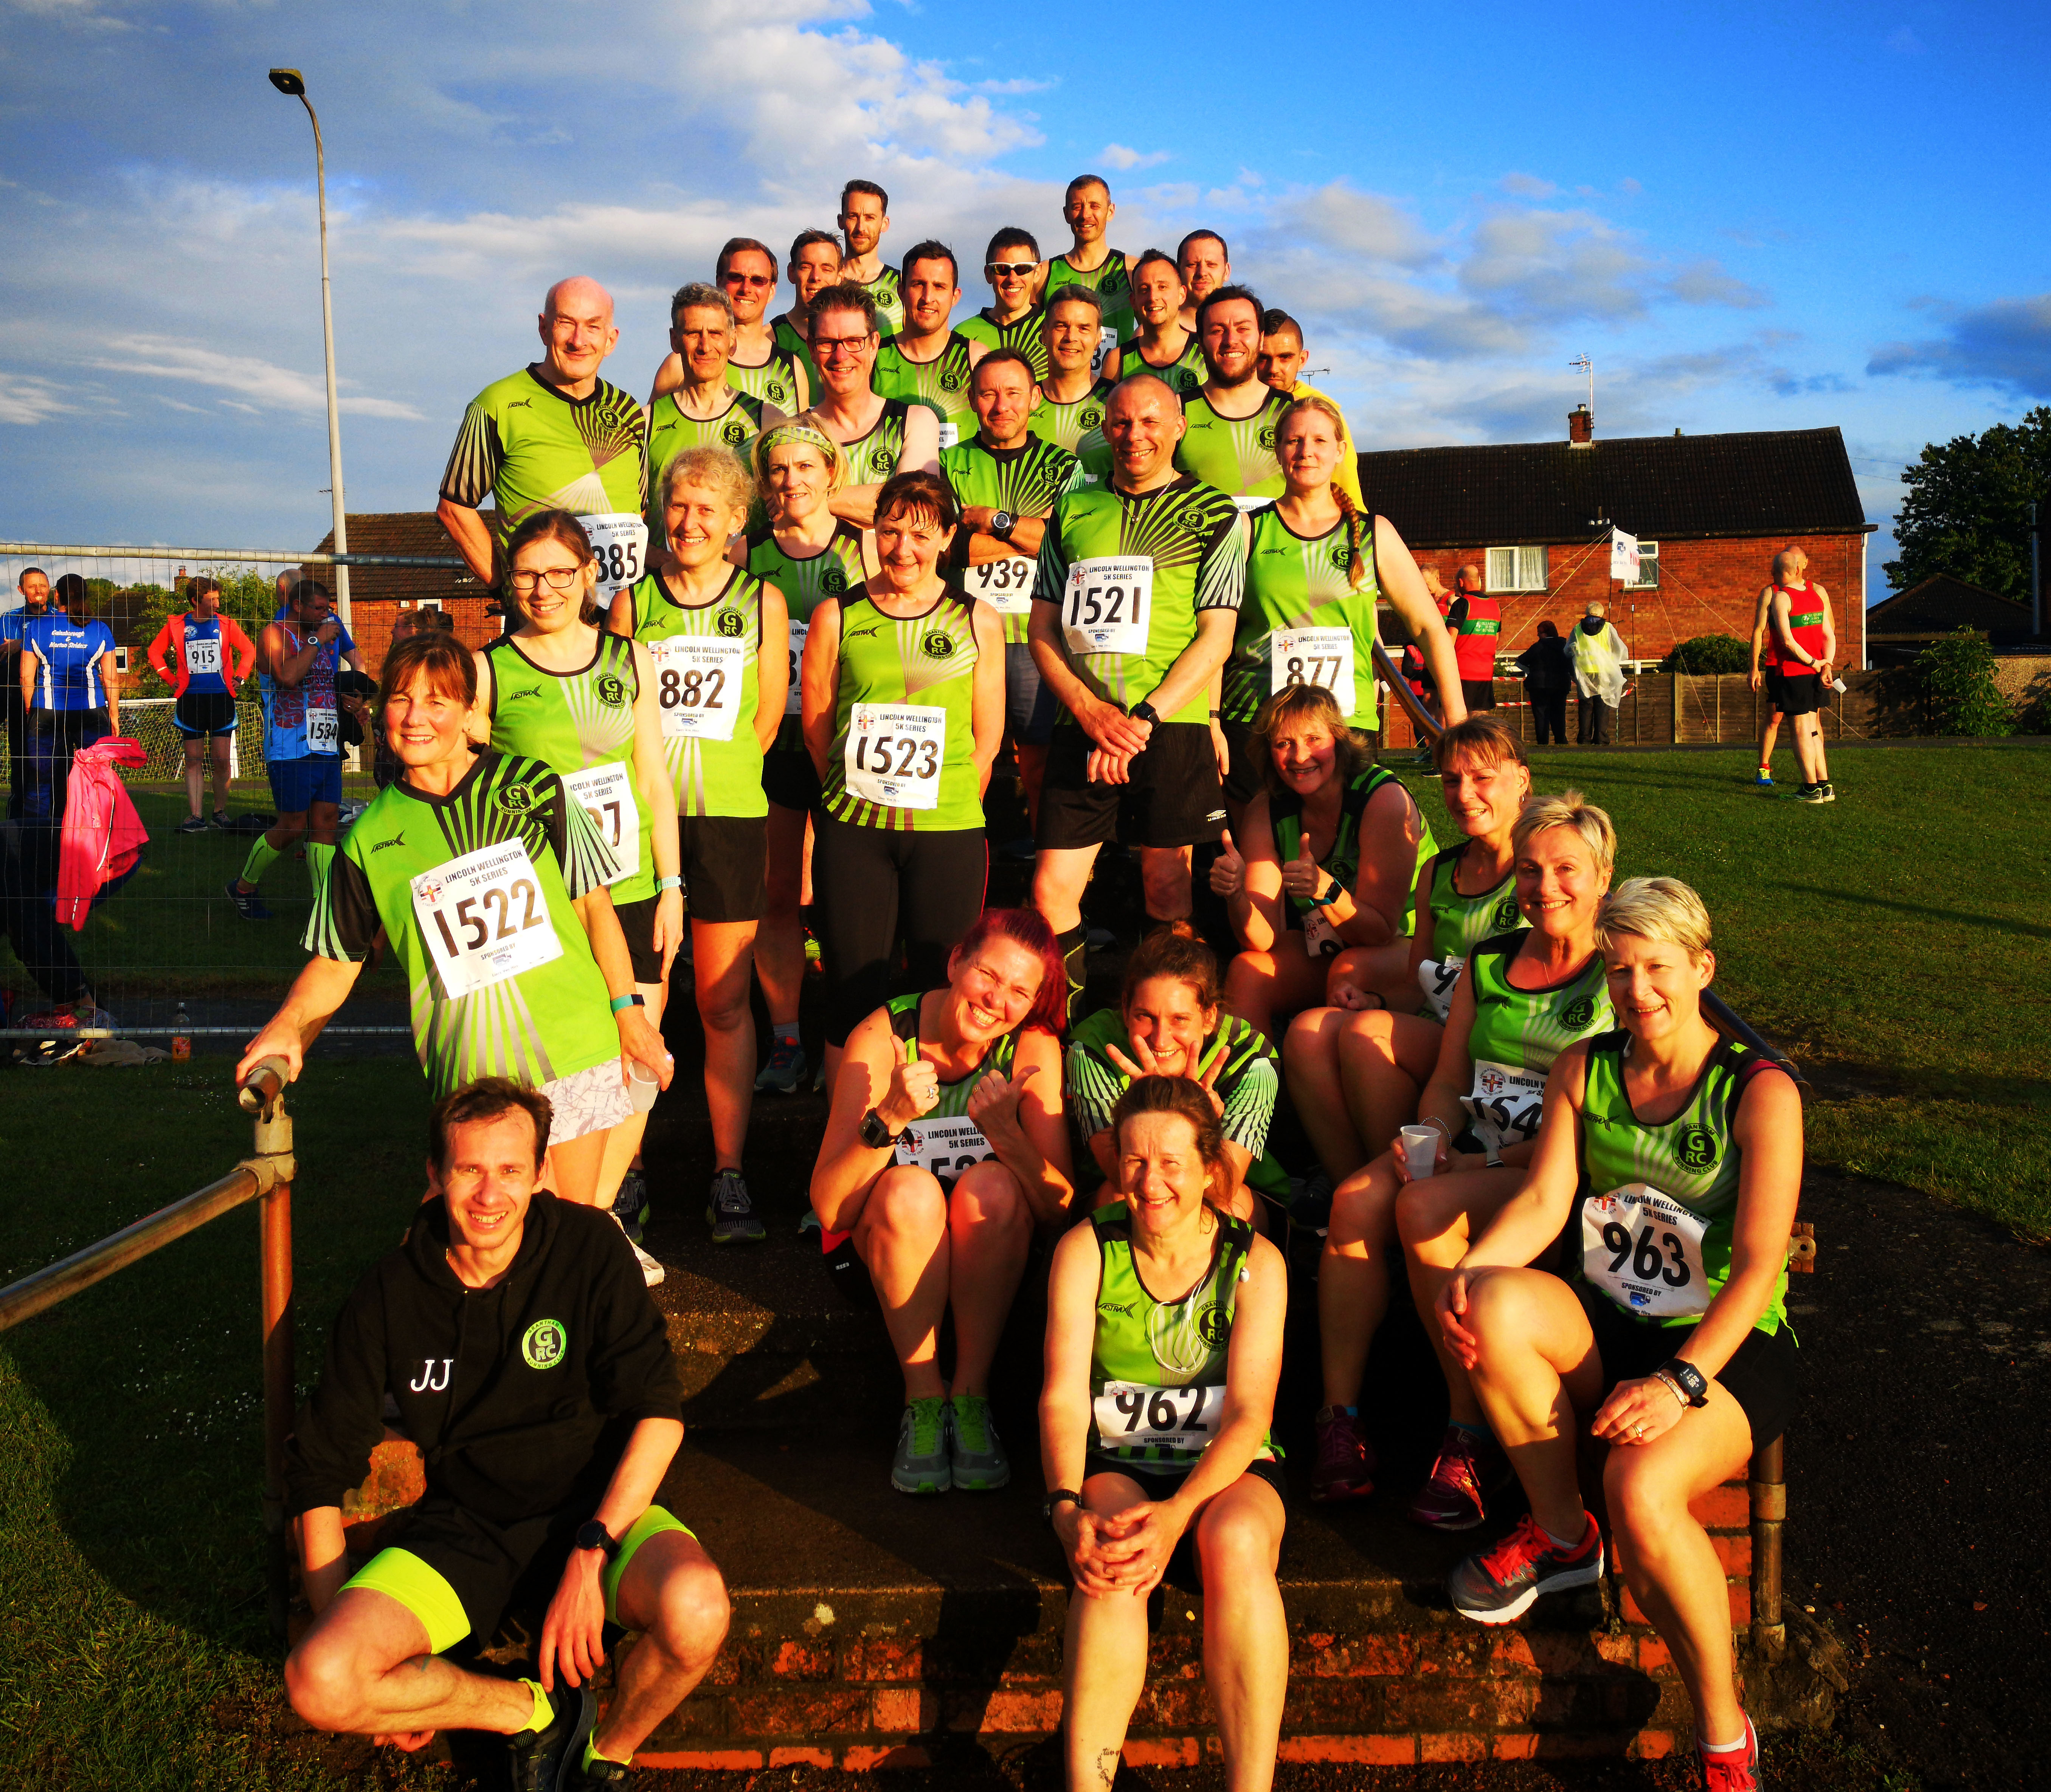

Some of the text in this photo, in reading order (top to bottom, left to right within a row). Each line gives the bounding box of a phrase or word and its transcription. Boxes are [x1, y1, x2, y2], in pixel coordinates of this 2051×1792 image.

[945, 373, 953, 383] G
[1184, 372, 1193, 381] G
[771, 384, 780, 394] G
[603, 410, 612, 422] G
[1085, 412, 1095, 420] G
[729, 425, 739, 436] G
[1264, 429, 1275, 440] G
[877, 451, 888, 462] G
[1045, 466, 1053, 475] G
[1185, 511, 1199, 522] G
[1337, 549, 1348, 560] G
[828, 573, 839, 584] G
[977, 560, 1029, 589] 939
[1070, 586, 1142, 626] 1521
[724, 612, 737, 626] G
[724, 626, 738, 636] RC
[931, 635, 944, 648] G
[192, 650, 215, 664] 915
[1286, 656, 1343, 691] 877
[510, 683, 542, 700] FASTRAX
[604, 678, 617, 692] G
[659, 668, 726, 709] 882
[607, 692, 621, 701] RC
[906, 715, 942, 724] WELLINGTON
[310, 722, 338, 740] 1534
[856, 736, 938, 779] 1523
[592, 773, 623, 786] WELLINGTON
[506, 786, 521, 800] G
[594, 786, 612, 797] SERIES
[508, 800, 526, 808] RC
[370, 829, 406, 855] FASTRAX
[445, 849, 523, 884] LINCOLN WELLINGTON
[469, 867, 509, 887] 5K SERIES
[1502, 902, 1516, 917] G
[433, 878, 544, 958] 1522
[1499, 917, 1514, 926] RC
[481, 946, 509, 960] SPONSORED
[1559, 1018, 1595, 1031] RUNNING CLUB
[1569, 1013, 1586, 1023] RC
[1509, 1076, 1539, 1088] LINCOLN
[928, 1129, 957, 1139] LINCOLN
[1682, 1123, 1715, 1136] GRANTHAM
[949, 1137, 985, 1149] 5K SERIES
[1687, 1132, 1705, 1152] G
[1685, 1151, 1707, 1164] RC
[1674, 1156, 1718, 1174] RUNNING CLUB
[1643, 1207, 1678, 1225] 5K SERIES
[1652, 1198, 1705, 1225] WELLINGTON
[1603, 1221, 1691, 1287] 963
[1621, 1282, 1653, 1296] SPONSORED
[1098, 1301, 1139, 1319] FASTRAX
[1208, 1309, 1223, 1328] G
[528, 1320, 559, 1333] GRANTHAM
[535, 1326, 552, 1347] G
[1208, 1328, 1224, 1341] RC
[527, 1350, 564, 1368] RUNNING CLUB
[535, 1344, 556, 1361] RC
[410, 1359, 454, 1392] JJ
[1115, 1386, 1208, 1432] 962
